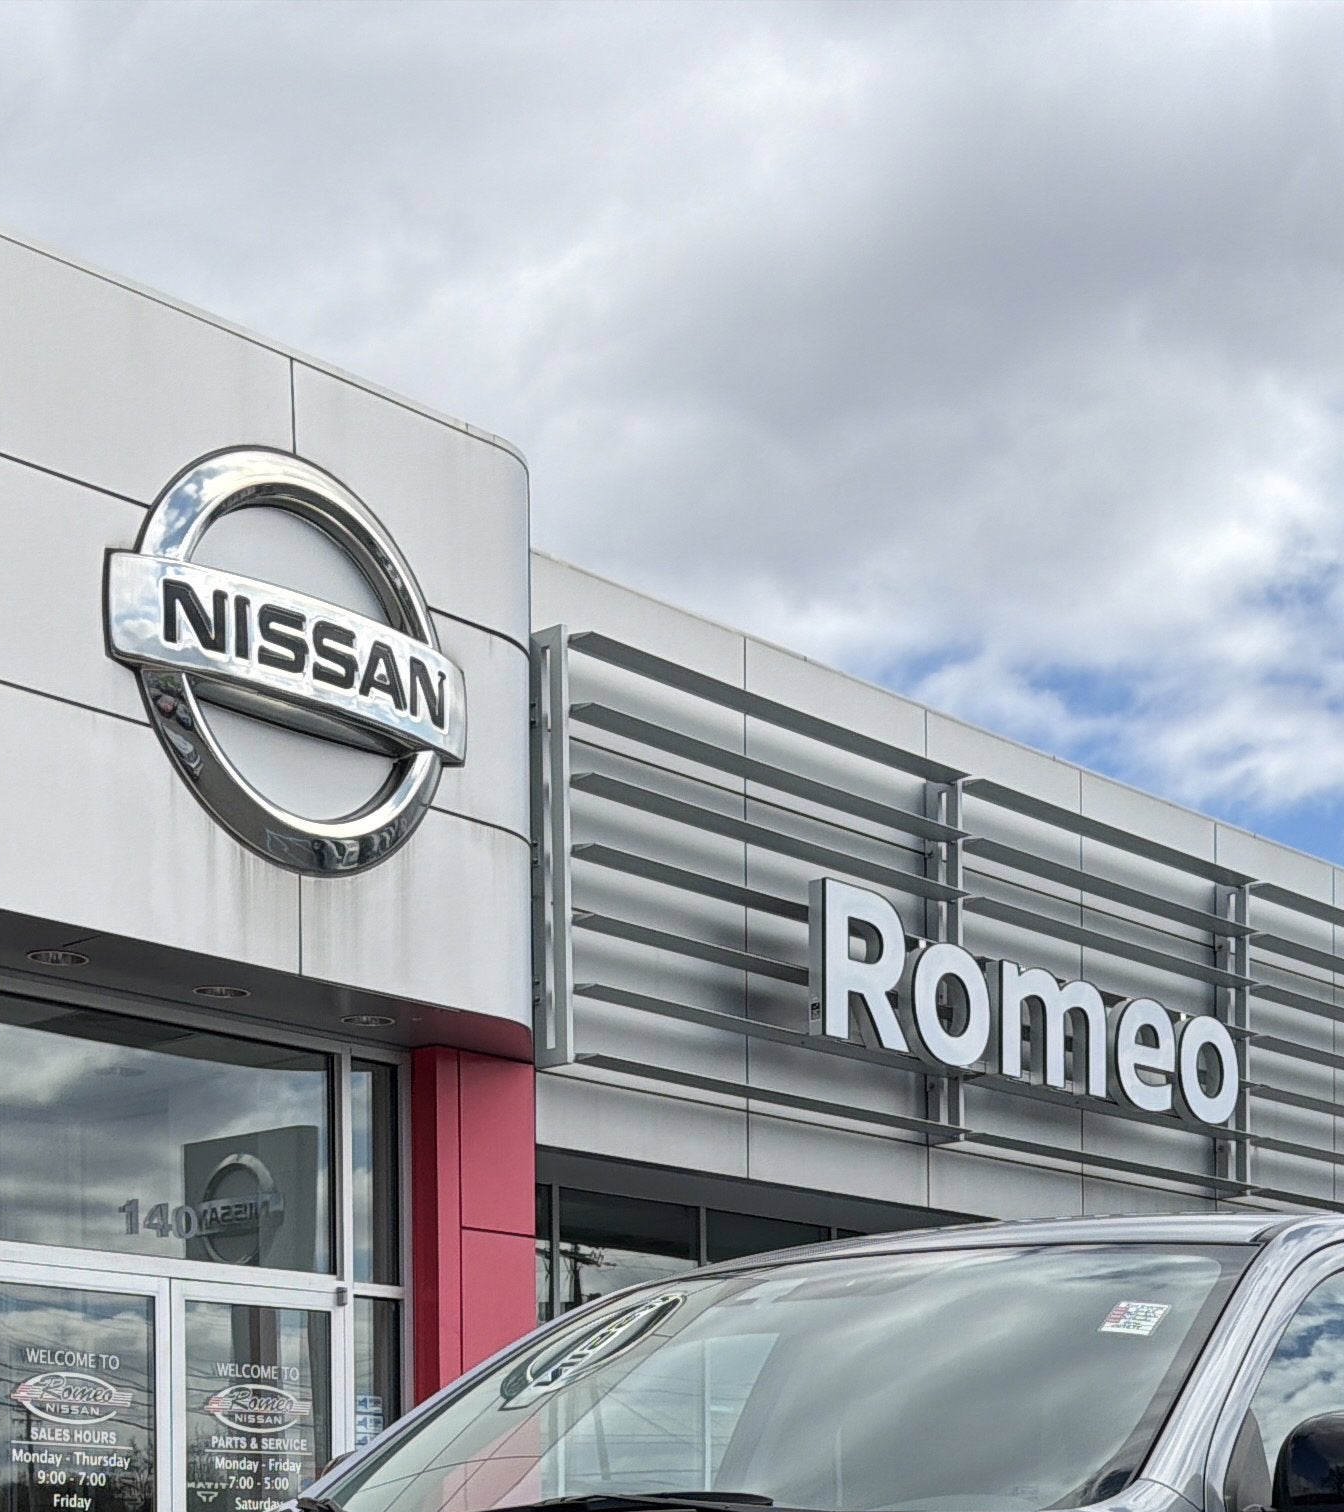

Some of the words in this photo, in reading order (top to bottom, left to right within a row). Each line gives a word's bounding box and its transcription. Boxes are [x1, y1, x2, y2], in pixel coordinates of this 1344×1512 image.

[162, 577, 448, 731] NISSAN
[810, 876, 1240, 1125] Romeo
[118, 1199, 198, 1240] 140
[26, 1347, 96, 1368] WELCOME
[99, 1354, 120, 1370] TO
[217, 1362, 278, 1380] WELCOME
[281, 1367, 299, 1380] TO
[38, 1374, 114, 1403] Romeo
[228, 1387, 294, 1411] Romeo
[45, 1403, 100, 1416] NISSAN
[234, 1413, 283, 1425] NISSAN
[30, 1427, 70, 1441] SALES
[74, 1429, 116, 1444] HOURS
[211, 1435, 247, 1449] PARTS
[250, 1437, 258, 1450] &
[261, 1438, 307, 1450] SERVICE
[12, 1448, 62, 1467] Monday
[74, 1451, 131, 1470] Thursday
[214, 1456, 259, 1473] Monday
[268, 1458, 302, 1473] Friday
[37, 1470, 66, 1485] 9:00
[78, 1472, 106, 1486] 7:00
[228, 1476, 254, 1489] 7:00
[264, 1477, 289, 1490] 5:00
[53, 1494, 92, 1511] Friday
